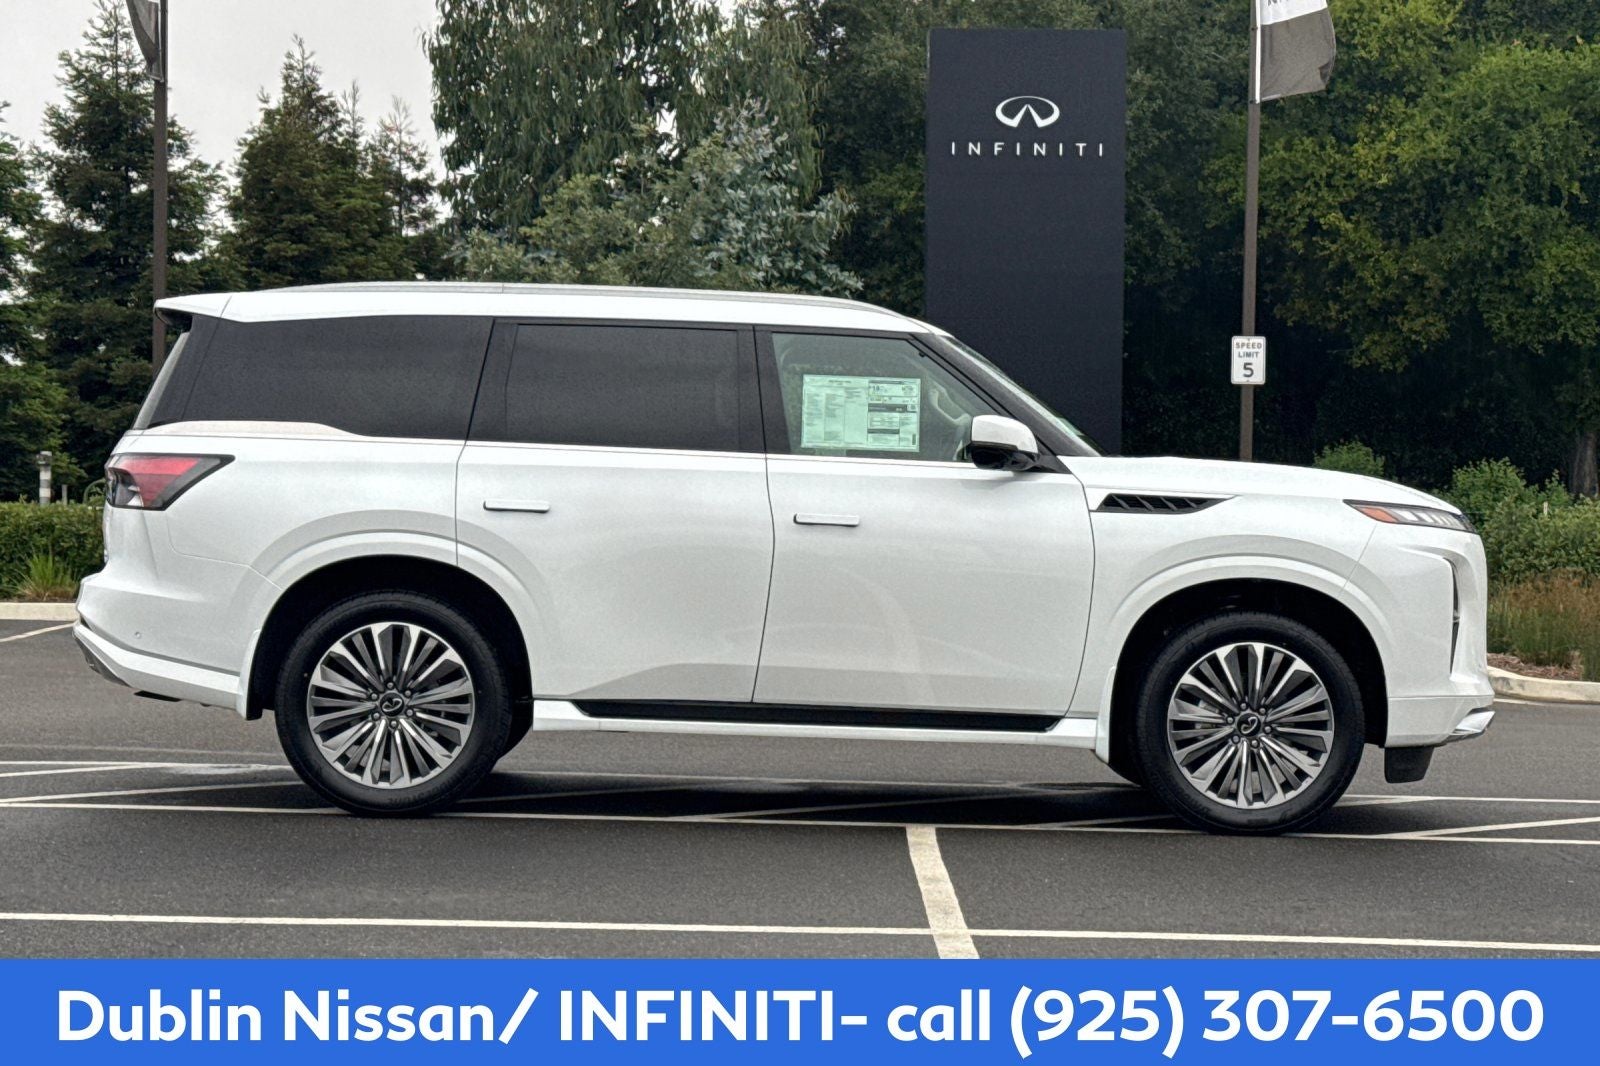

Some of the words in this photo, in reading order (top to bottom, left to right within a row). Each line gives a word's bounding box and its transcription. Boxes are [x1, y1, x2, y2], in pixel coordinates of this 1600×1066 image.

[951, 141, 1103, 157] INFINITI
[1235, 342, 1262, 350] SPEED
[1237, 351, 1260, 359] LIMIT
[1243, 362, 1254, 378] 5
